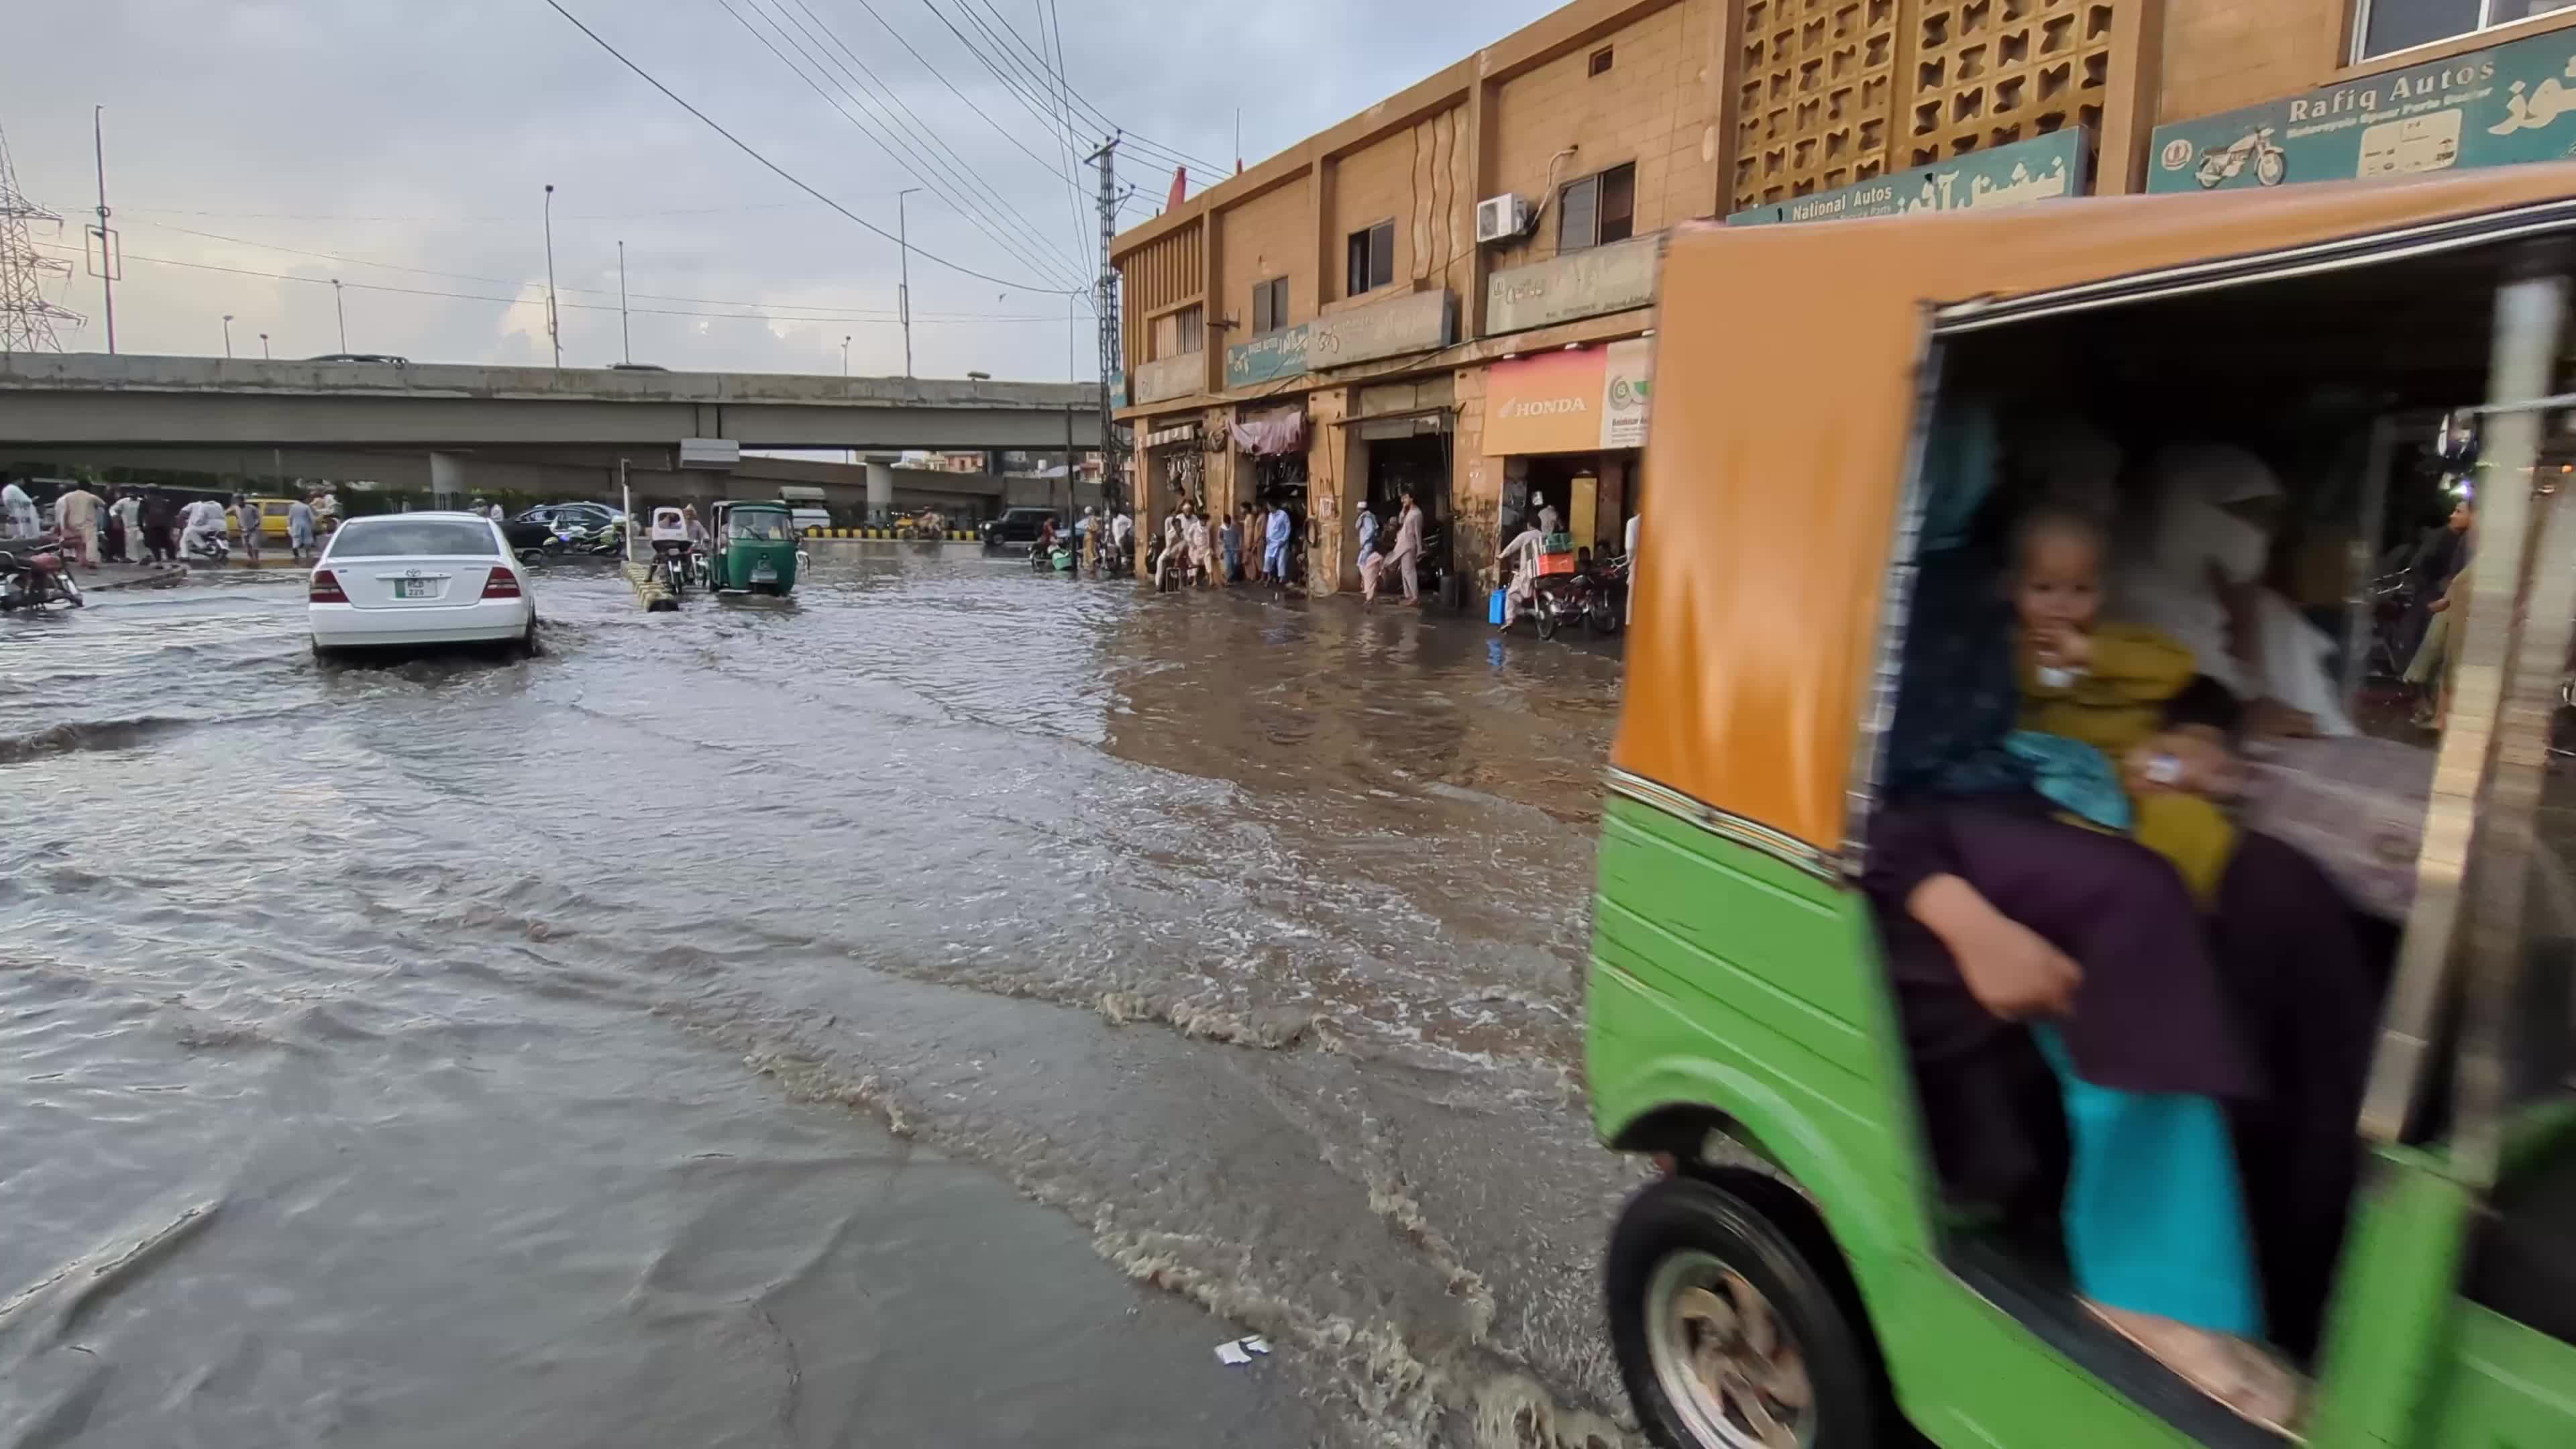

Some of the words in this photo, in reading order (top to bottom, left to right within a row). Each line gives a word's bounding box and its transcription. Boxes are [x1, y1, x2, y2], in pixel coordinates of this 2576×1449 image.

[2288, 89, 2377, 122] Rafiq
[2389, 62, 2495, 101] Autos
[1792, 193, 1846, 221] National
[1854, 186, 1892, 207] Autos
[1514, 396, 1588, 417] HONDA
